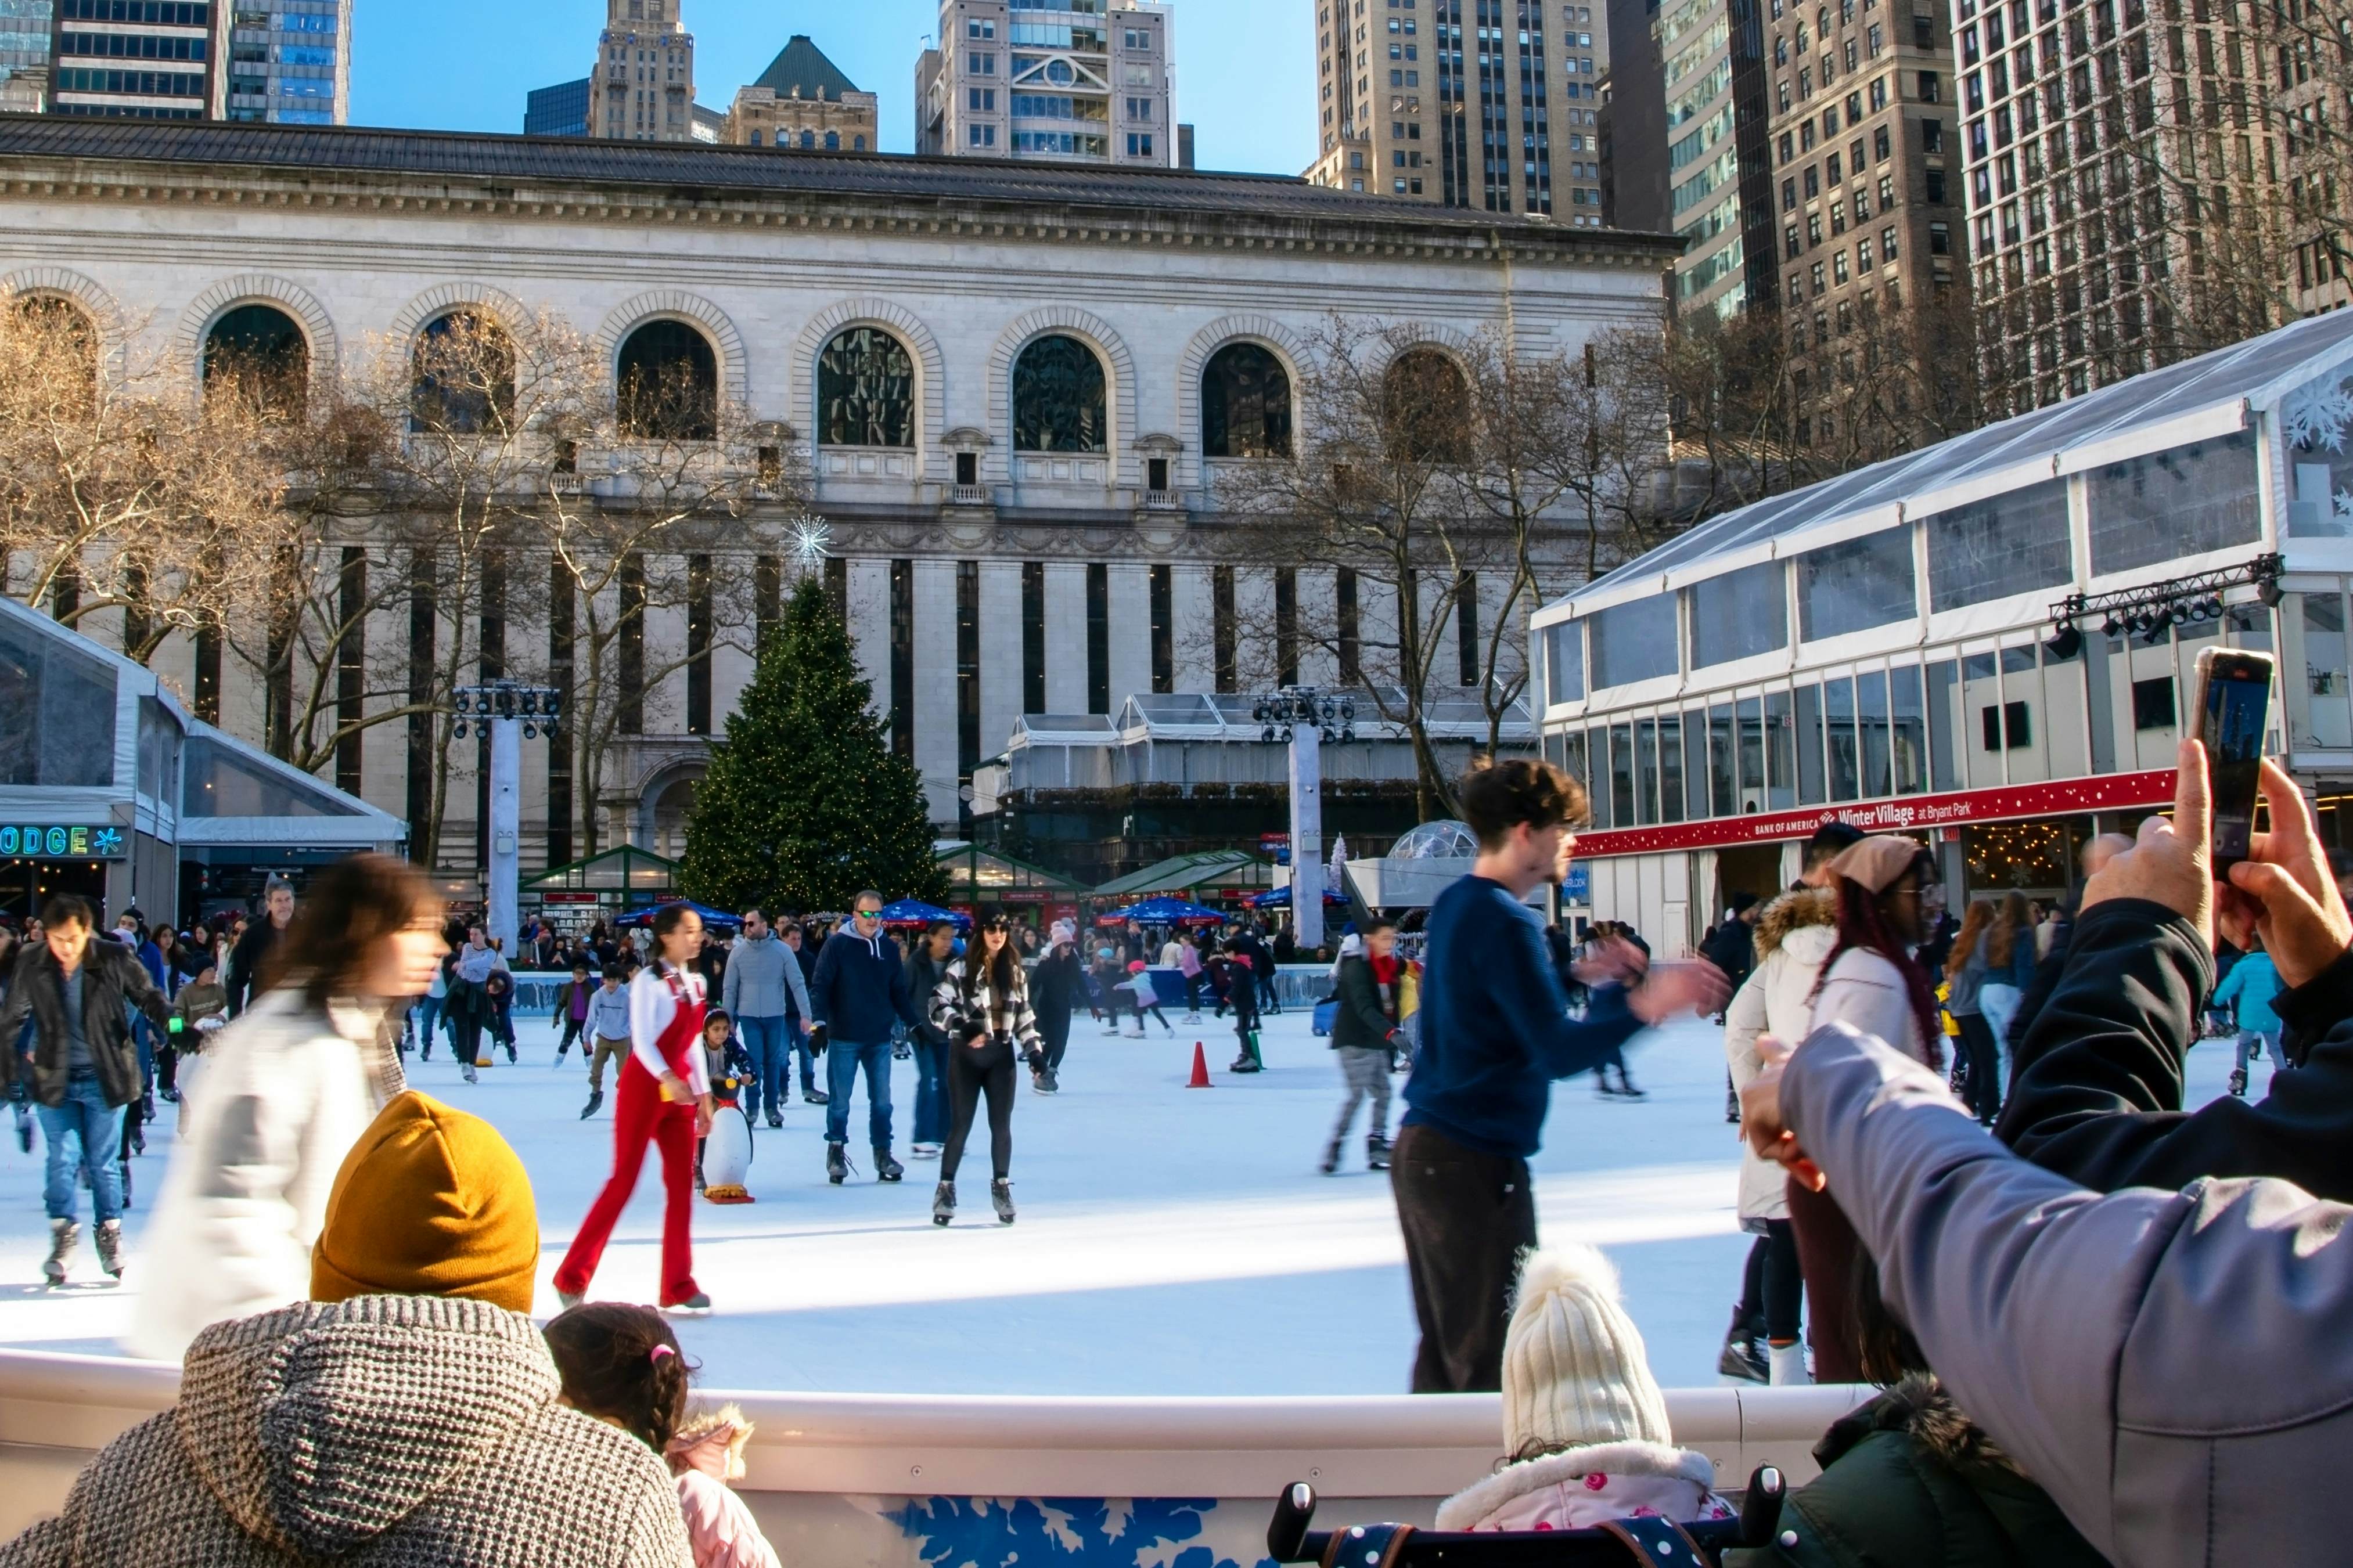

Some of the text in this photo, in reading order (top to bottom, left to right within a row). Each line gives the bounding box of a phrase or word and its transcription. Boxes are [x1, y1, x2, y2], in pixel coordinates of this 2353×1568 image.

[1755, 802, 1971, 835] BANK OF AMERICA Winter Village at Bryant Park
[0, 827, 88, 855] ODGE
[1562, 878, 1586, 888] VERLOOK
